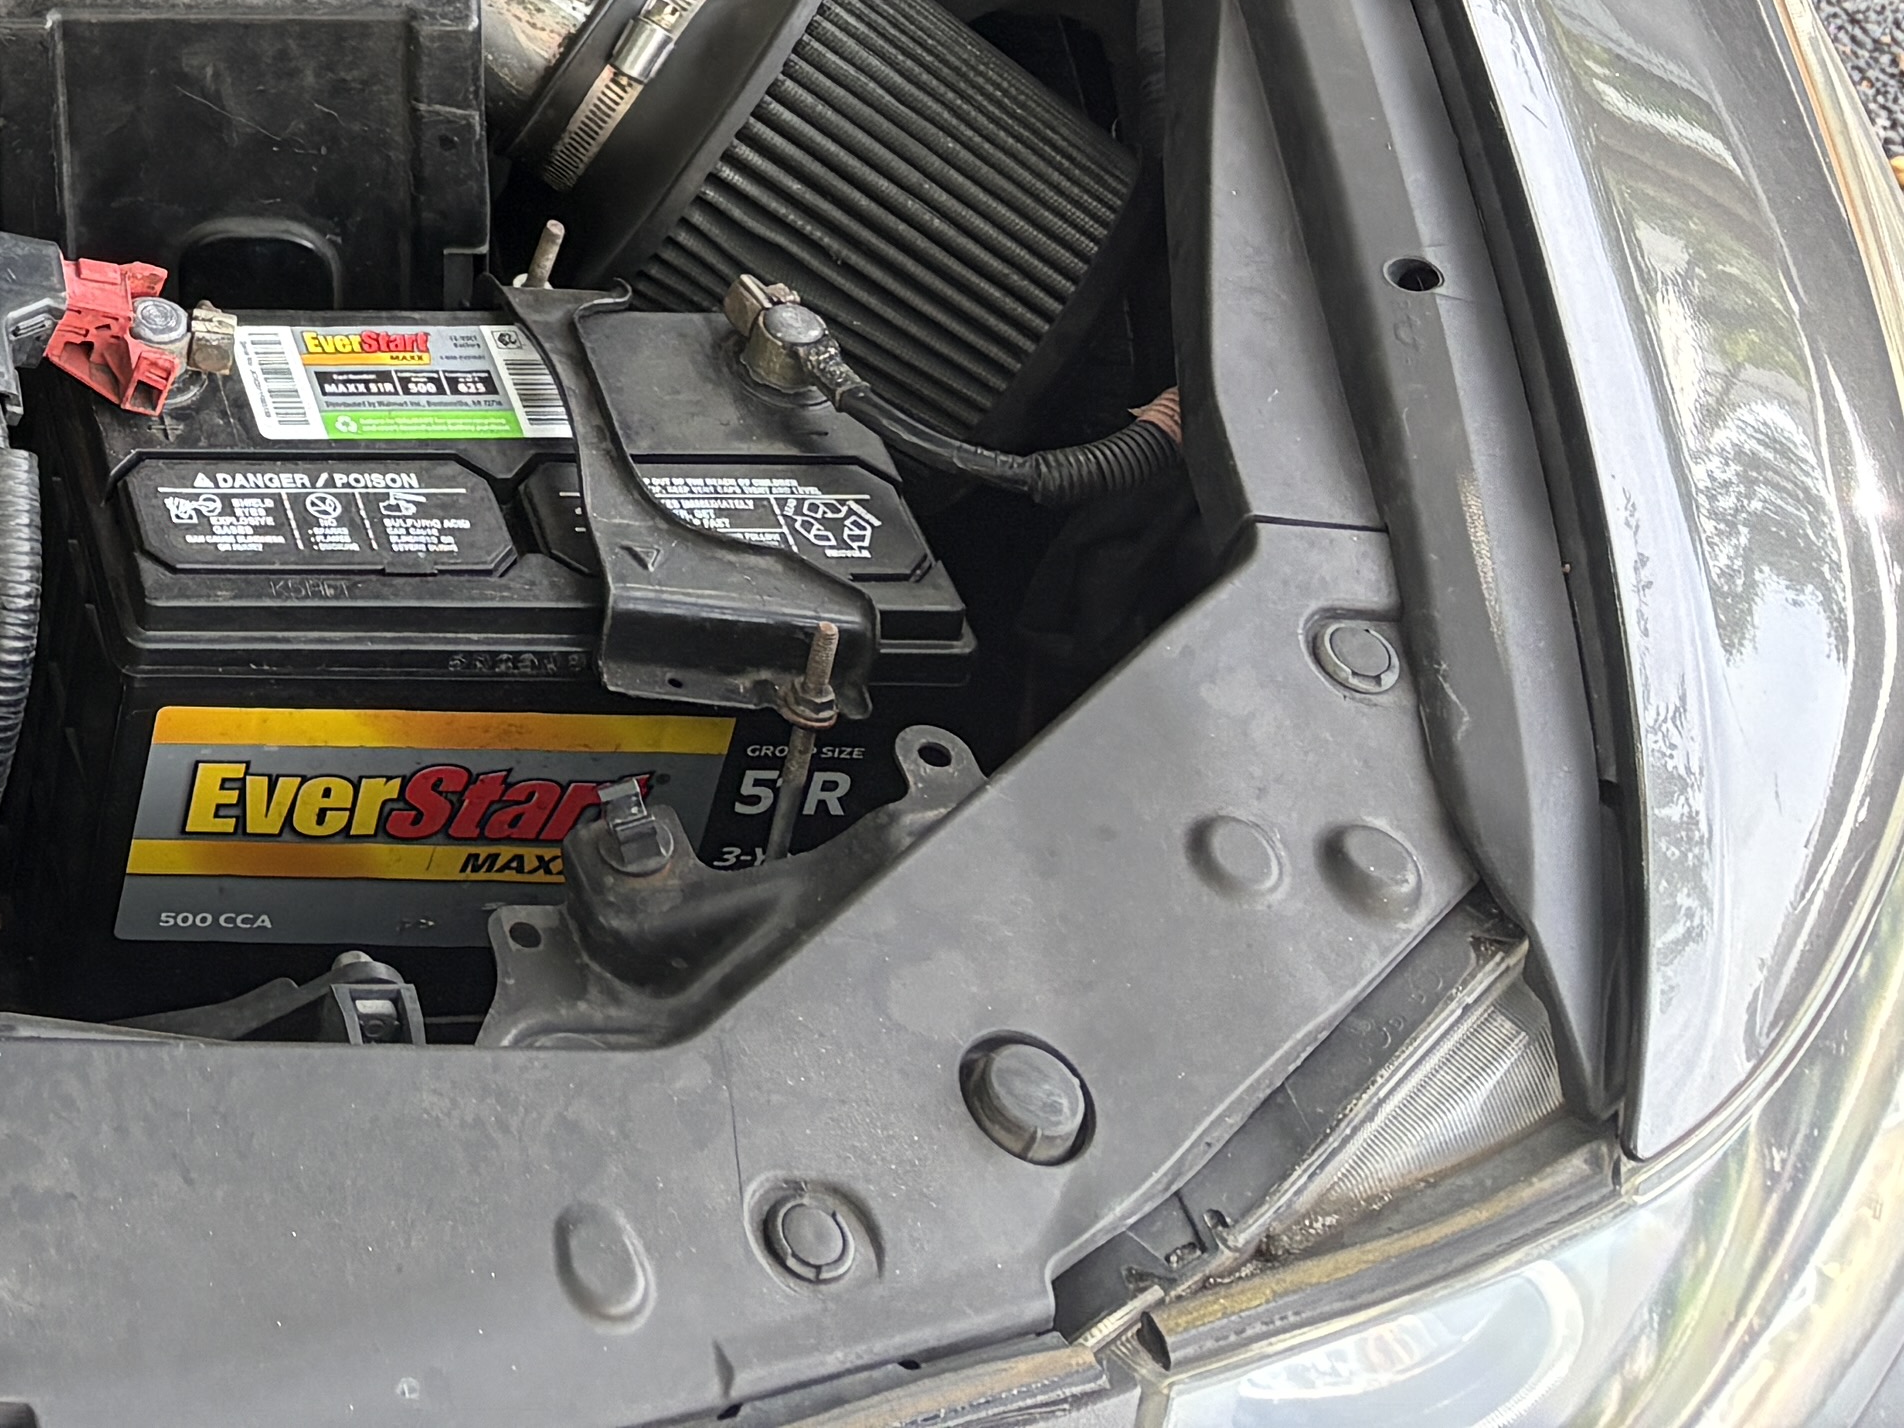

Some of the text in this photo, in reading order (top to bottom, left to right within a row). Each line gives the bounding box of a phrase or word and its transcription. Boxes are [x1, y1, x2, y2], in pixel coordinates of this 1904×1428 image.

[302, 329, 430, 355] EverStart
[389, 354, 425, 363] MAXX
[323, 382, 367, 394] MAXX
[407, 382, 437, 394] 500
[215, 472, 311, 488] DANGER
[333, 472, 420, 489] POISON
[819, 746, 866, 759] SIZE
[183, 760, 652, 841] EverStar
[734, 769, 852, 816] 5R
[159, 912, 273, 929] 500 CCA
